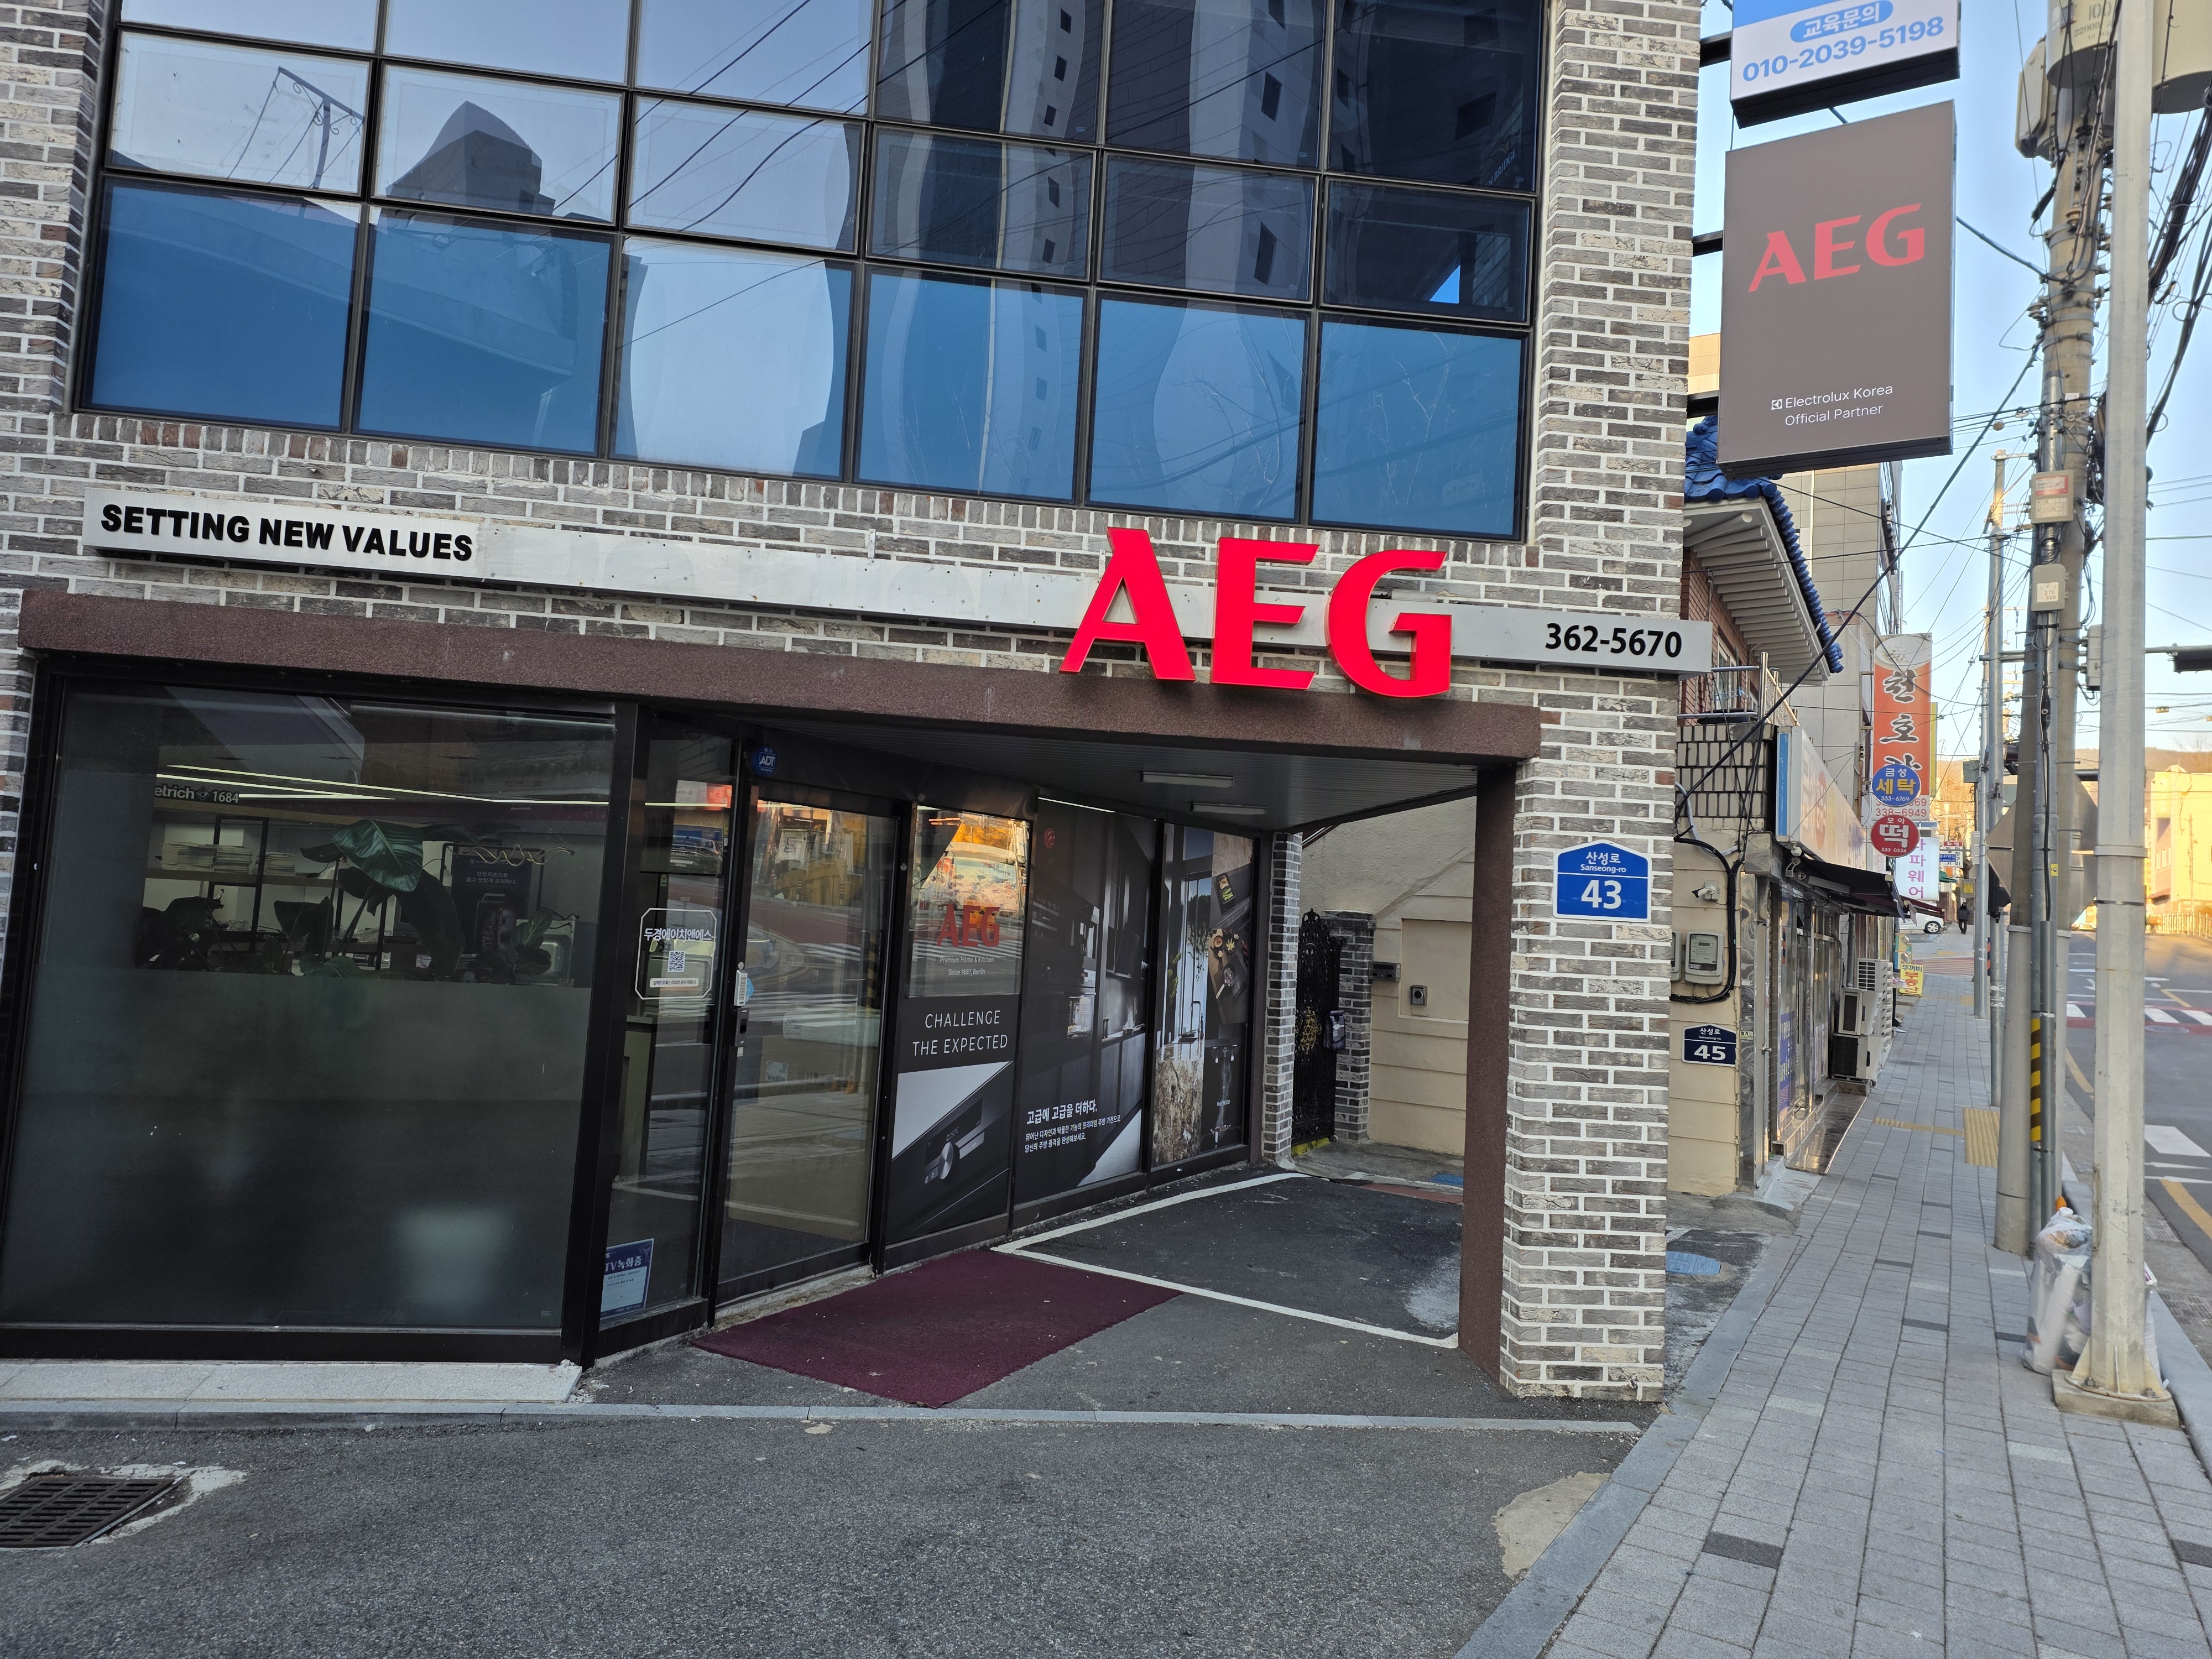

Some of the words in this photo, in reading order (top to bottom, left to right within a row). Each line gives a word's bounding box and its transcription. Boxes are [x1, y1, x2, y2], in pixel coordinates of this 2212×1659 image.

[1803, 6, 1880, 38] 교육문의
[1743, 16, 1944, 81] 010-2039-5198
[1748, 202, 1925, 292] AEG
[1786, 391, 1850, 408] Electrolux
[1854, 385, 1893, 398] Korea
[1785, 410, 1830, 426] Official
[1834, 404, 1884, 420] Partner
[101, 504, 249, 542] SETTING
[259, 518, 335, 550] NEW
[342, 525, 473, 561] VALUES
[1058, 526, 1453, 698] AEG
[1545, 623, 1682, 658] 362-5670
[759, 755, 775, 766] ADT
[1885, 768, 1907, 778] 금성
[213, 791, 239, 804] 1684
[1876, 778, 1916, 795] 세탁
[1875, 808, 1927, 817] 338-6949
[1879, 824, 1910, 848] 떡
[1580, 864, 1627, 874] Sanseong-ro
[1585, 852, 1621, 865] 산성로
[1580, 879, 1621, 909] 43
[644, 927, 712, 942] 두경에이치앤에스
[936, 904, 1000, 947] AEG
[961, 968, 972, 977] 1887,
[925, 1010, 1000, 1029] CHALLENGE
[1699, 1027, 1721, 1036] 산성로
[912, 1040, 938, 1057] THE
[944, 1034, 1008, 1053] EXPECTED
[1694, 1045, 1726, 1061] 45
[1026, 1107, 1050, 1124] 고급에
[1051, 1103, 1073, 1120] 고급을
[1075, 1099, 1098, 1115] 더하다.
[1025, 1131, 1039, 1142] 뛰어난
[1039, 1128, 1056, 1138] 디자인과
[1057, 1124, 1069, 1135] 탁월한
[1070, 1122, 1082, 1132] 기능의
[1082, 1119, 1098, 1129] 프리미엄
[1107, 1114, 1121, 1124] 가전으로
[1025, 1142, 1038, 1153] 당신의
[1039, 1141, 1048, 1150] 주방
[1048, 1138, 1061, 1148] 품격을
[1061, 1133, 1086, 1145] 완성해보세요.
